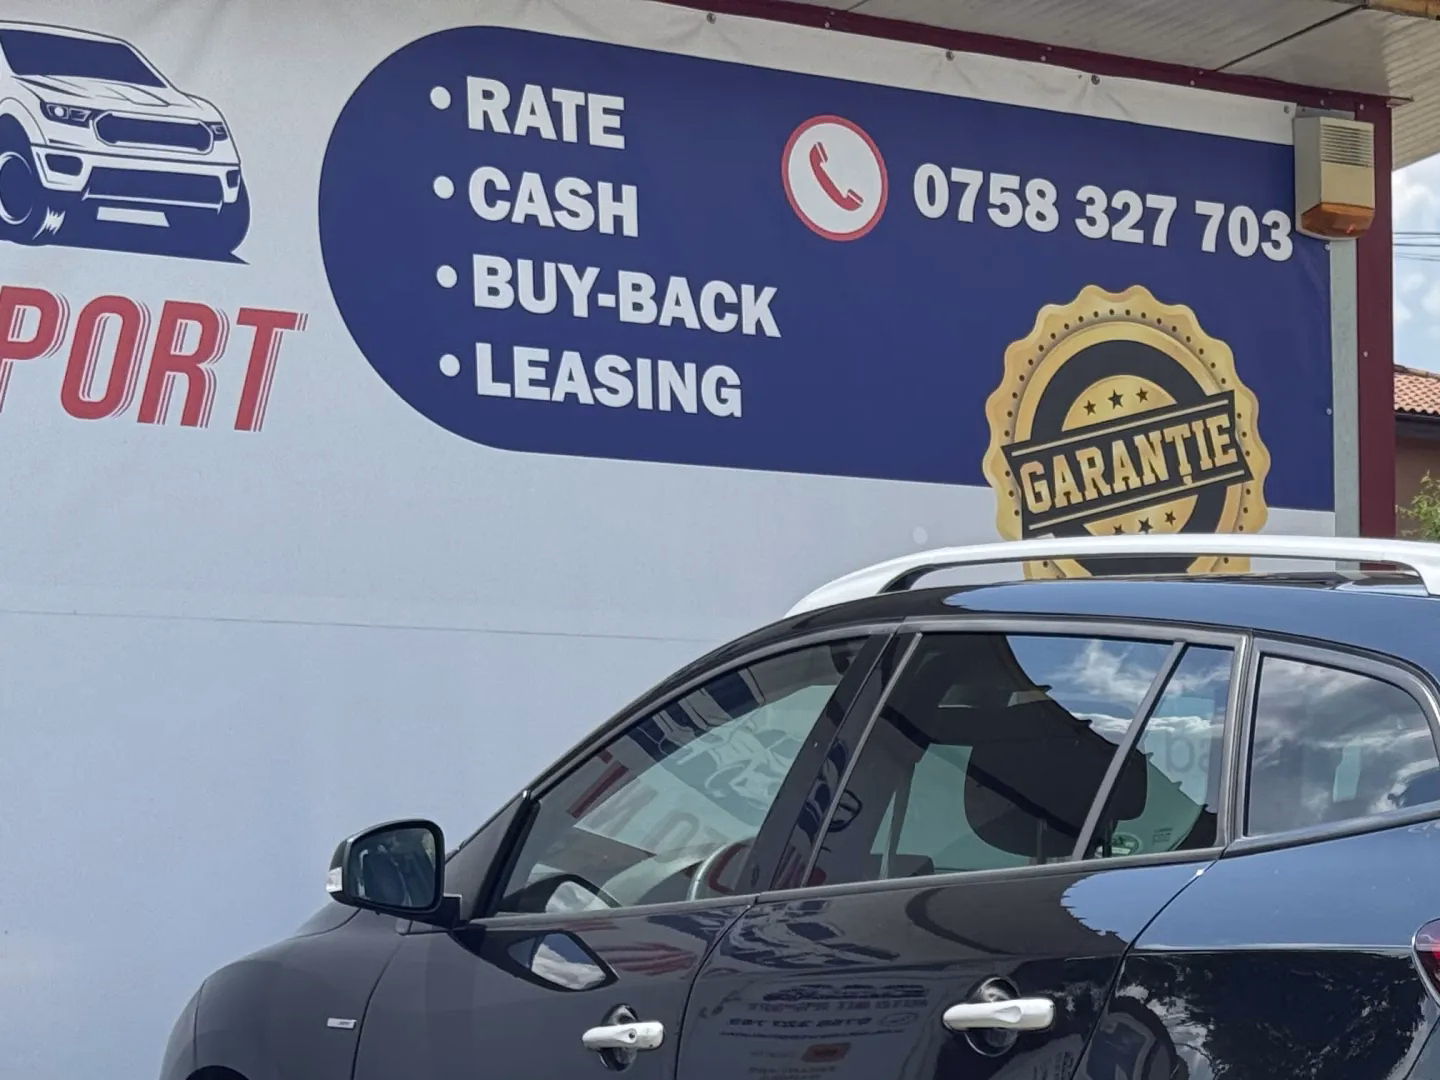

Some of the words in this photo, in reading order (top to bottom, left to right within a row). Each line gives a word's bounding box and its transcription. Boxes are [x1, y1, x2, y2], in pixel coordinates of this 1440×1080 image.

[466, 75, 626, 150] RATE
[468, 166, 639, 238] CASH
[913, 163, 1060, 233] 0758
[1075, 185, 1177, 247] 327
[1194, 202, 1293, 262] 703
[472, 253, 781, 338] BUY-BACK
[475, 342, 743, 419] LEASING
